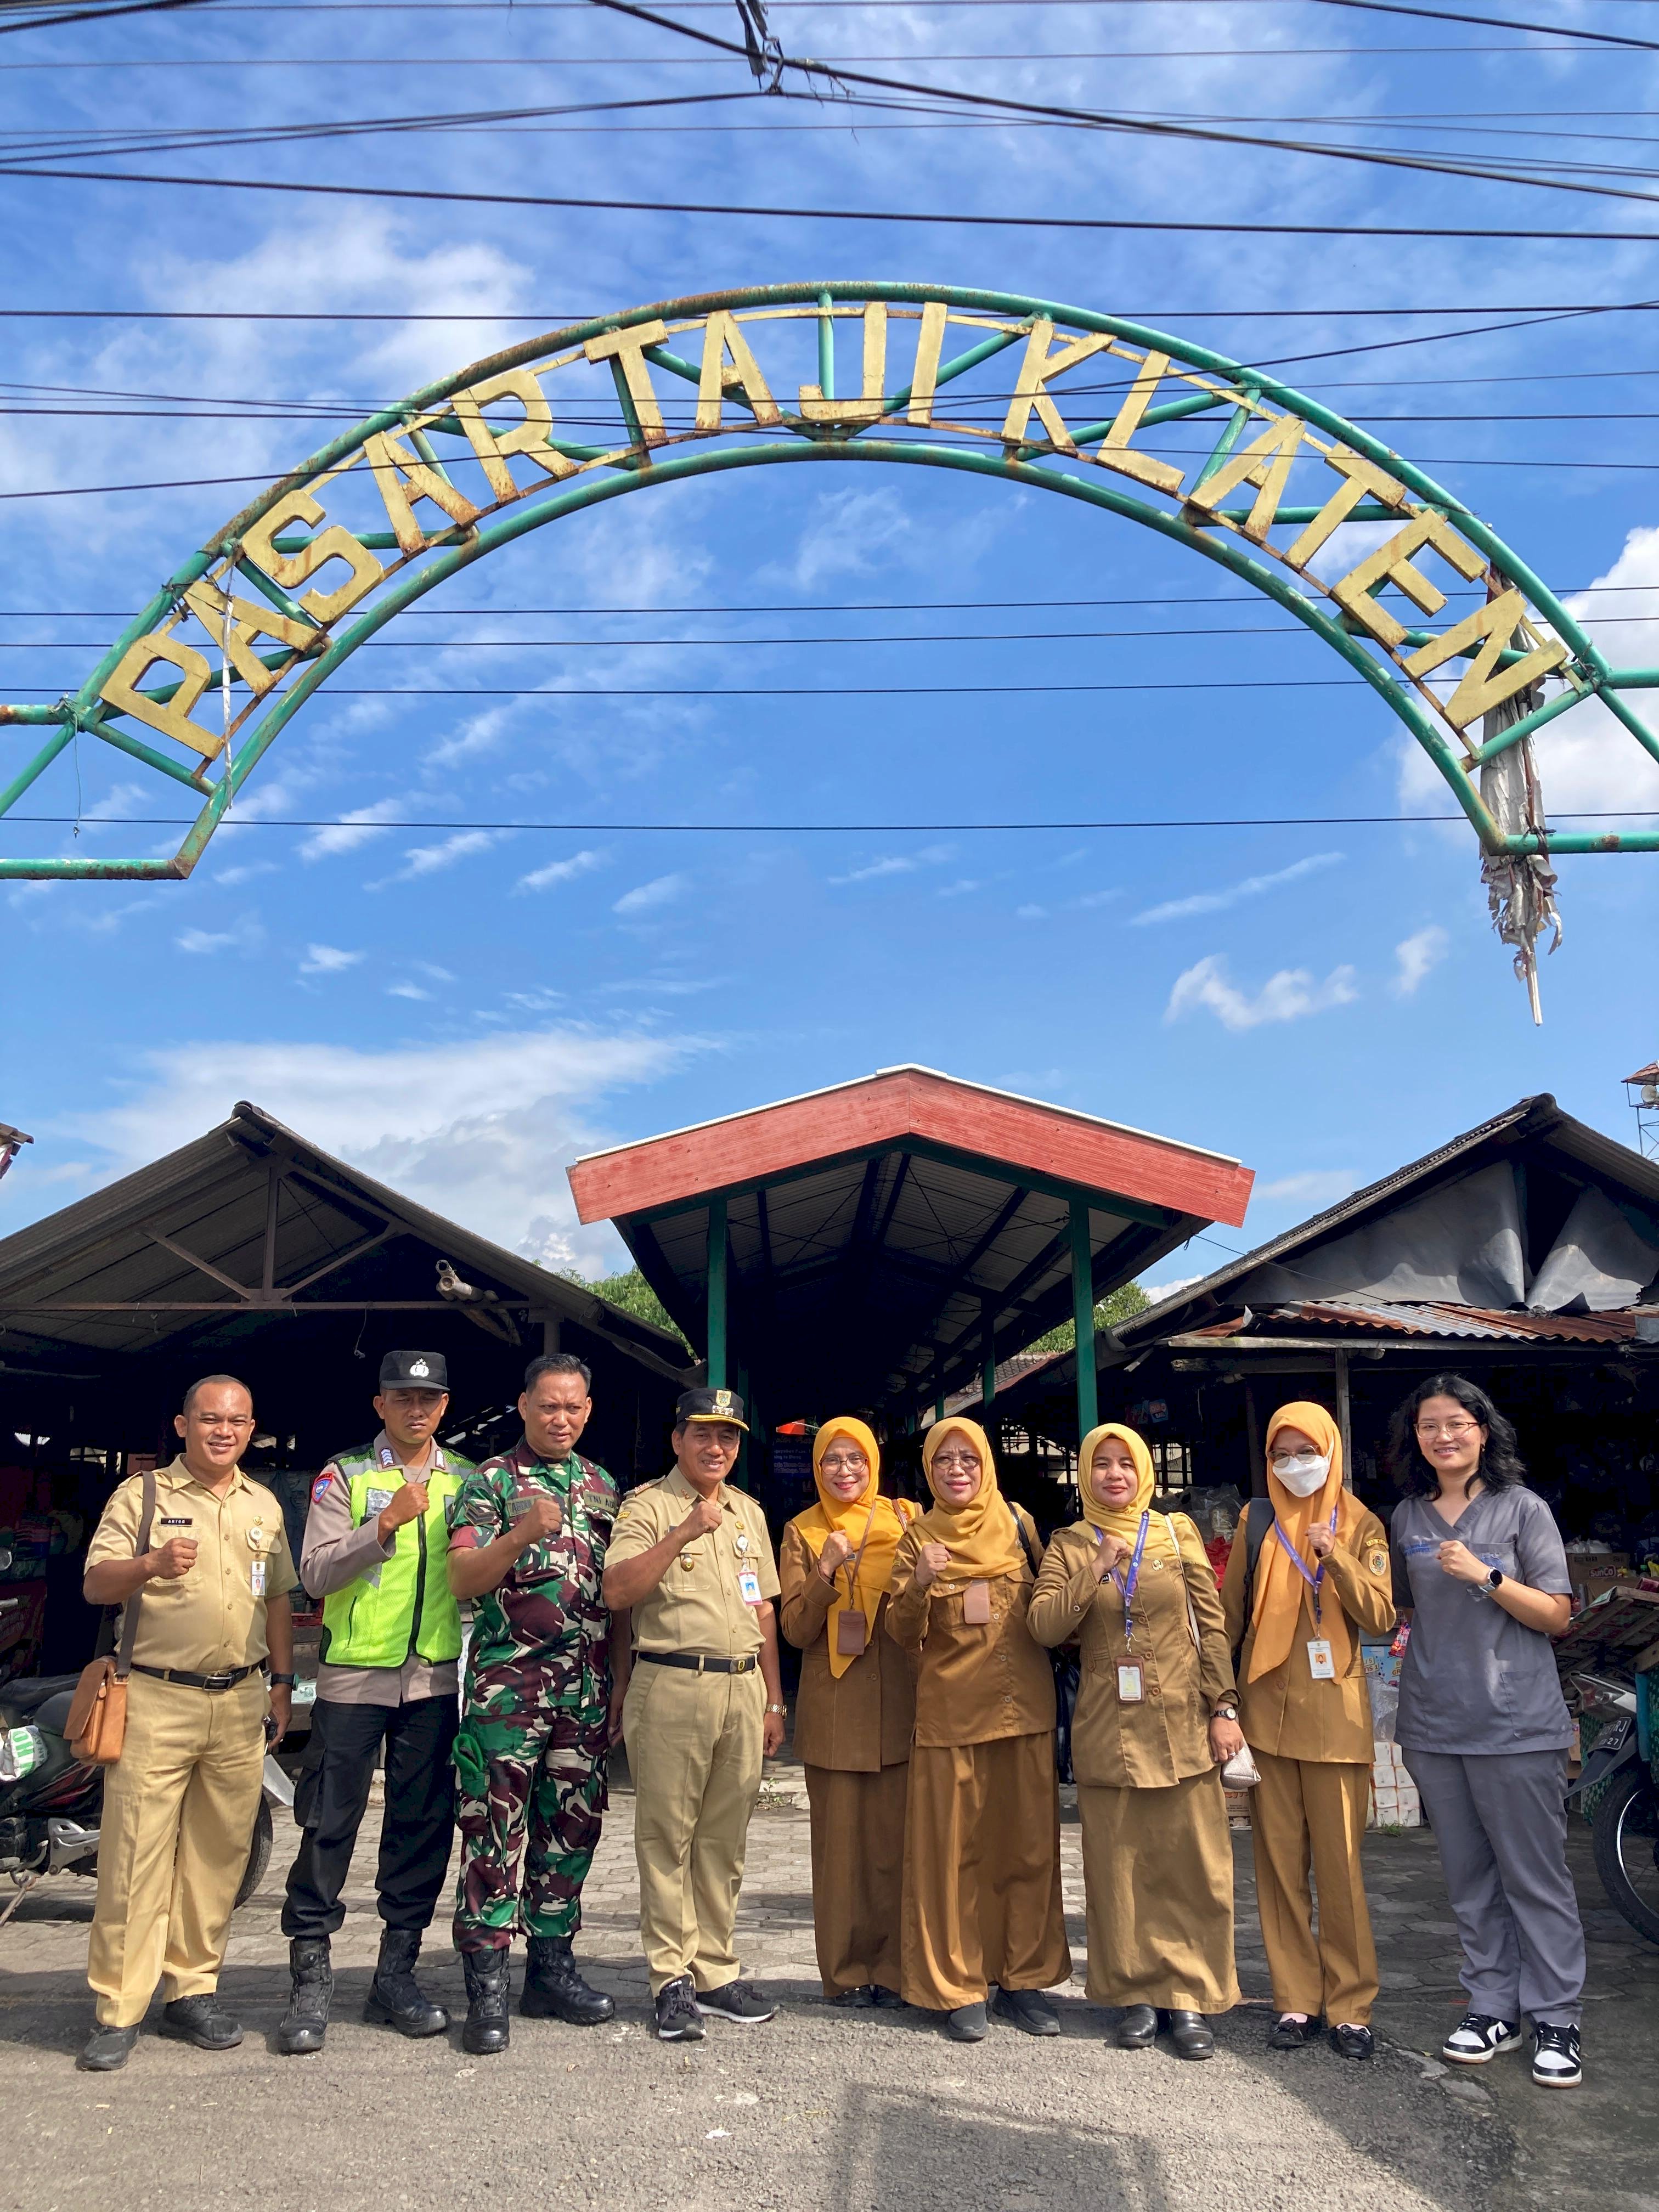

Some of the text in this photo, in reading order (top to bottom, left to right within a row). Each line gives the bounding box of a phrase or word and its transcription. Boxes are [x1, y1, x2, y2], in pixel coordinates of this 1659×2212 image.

[100, 301, 1568, 760] PASAR TAJI KLATEN
[588, 1495, 601, 1504] TNI
[1590, 1566, 1613, 1577] SunCo
